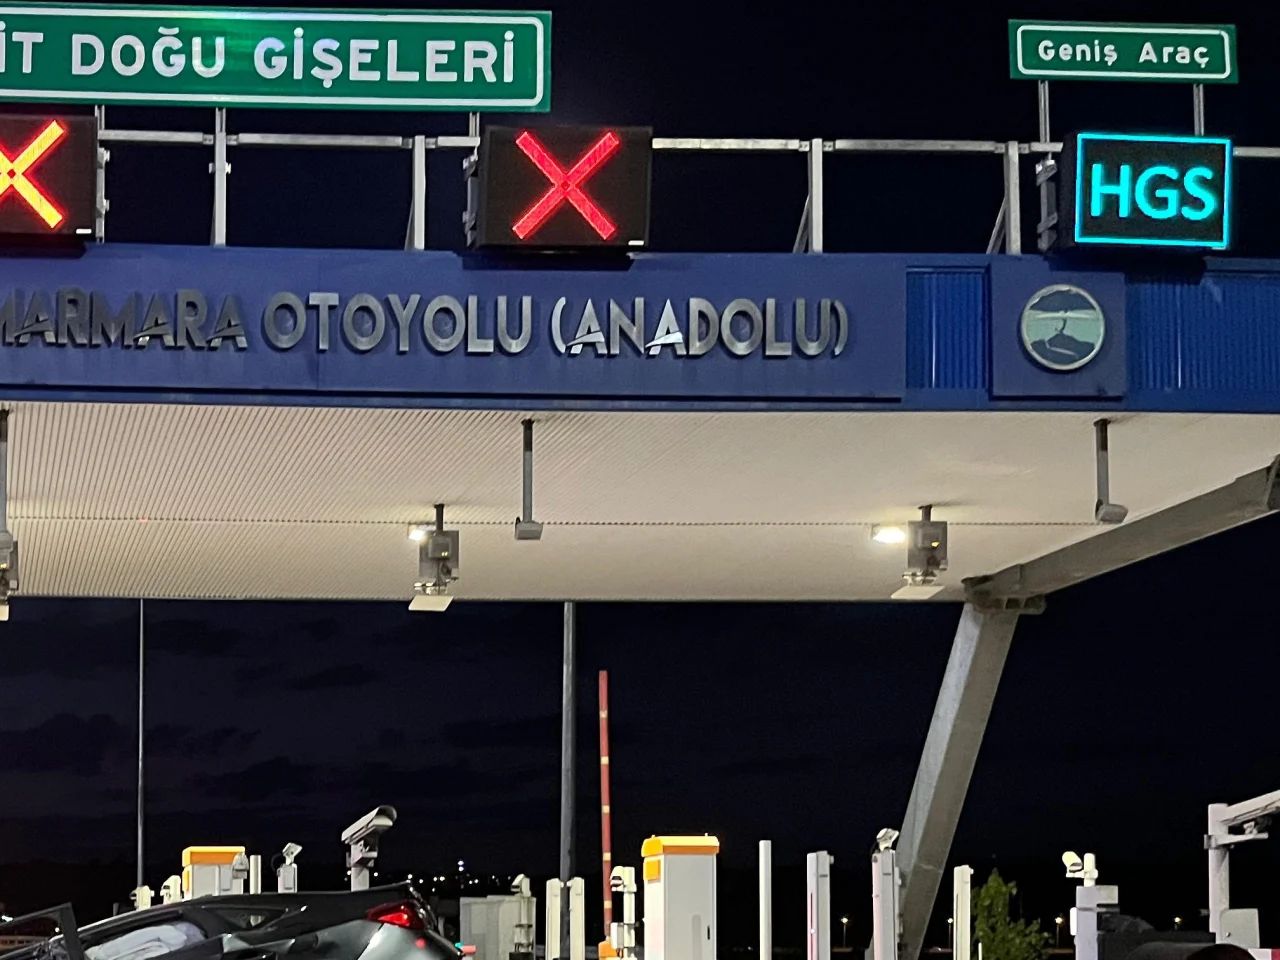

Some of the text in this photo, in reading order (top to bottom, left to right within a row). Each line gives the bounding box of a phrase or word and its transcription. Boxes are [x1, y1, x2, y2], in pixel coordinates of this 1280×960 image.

[71, 26, 226, 79] DOĞU
[253, 27, 515, 89] GİŞELERİ
[1037, 39, 1210, 69] Geniş Araç
[1090, 163, 1218, 221] HGS
[264, 291, 532, 355] OTOYOLU
[551, 296, 849, 357] (ANADOLU)
